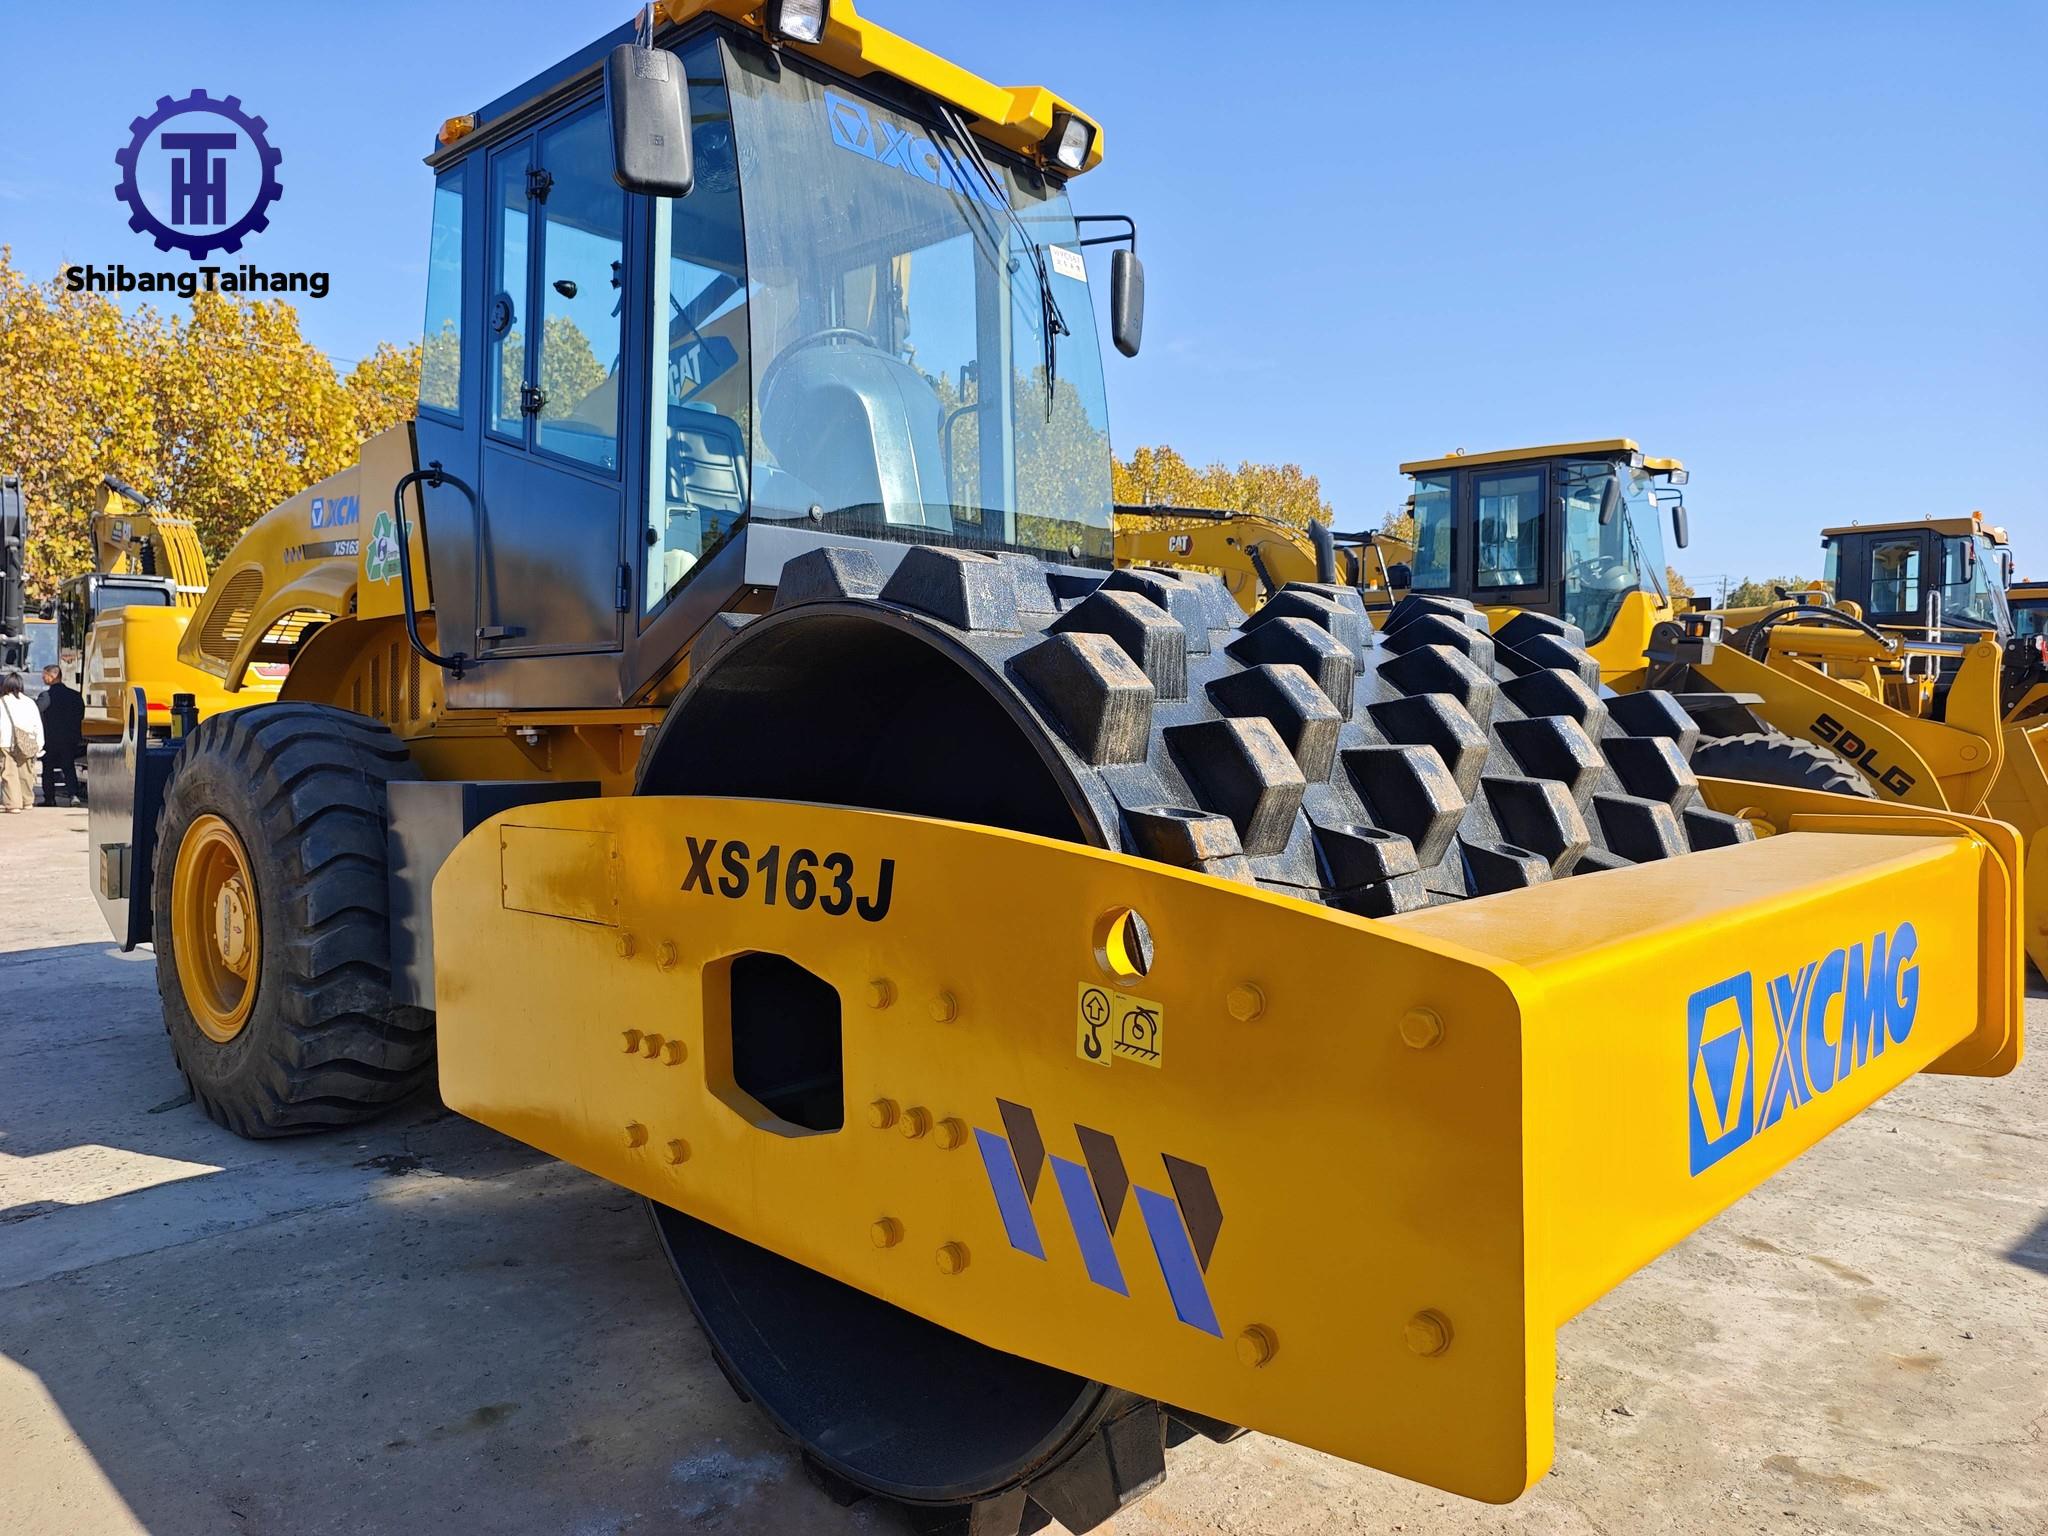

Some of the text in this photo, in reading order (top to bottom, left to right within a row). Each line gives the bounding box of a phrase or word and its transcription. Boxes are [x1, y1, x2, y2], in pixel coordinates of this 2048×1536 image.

[668, 343, 702, 400] CAT
[1168, 535, 1189, 552] CAT
[1809, 713, 1916, 797] SDLG
[680, 836, 896, 922] XS163J
[1754, 921, 1920, 1137] XCMG
